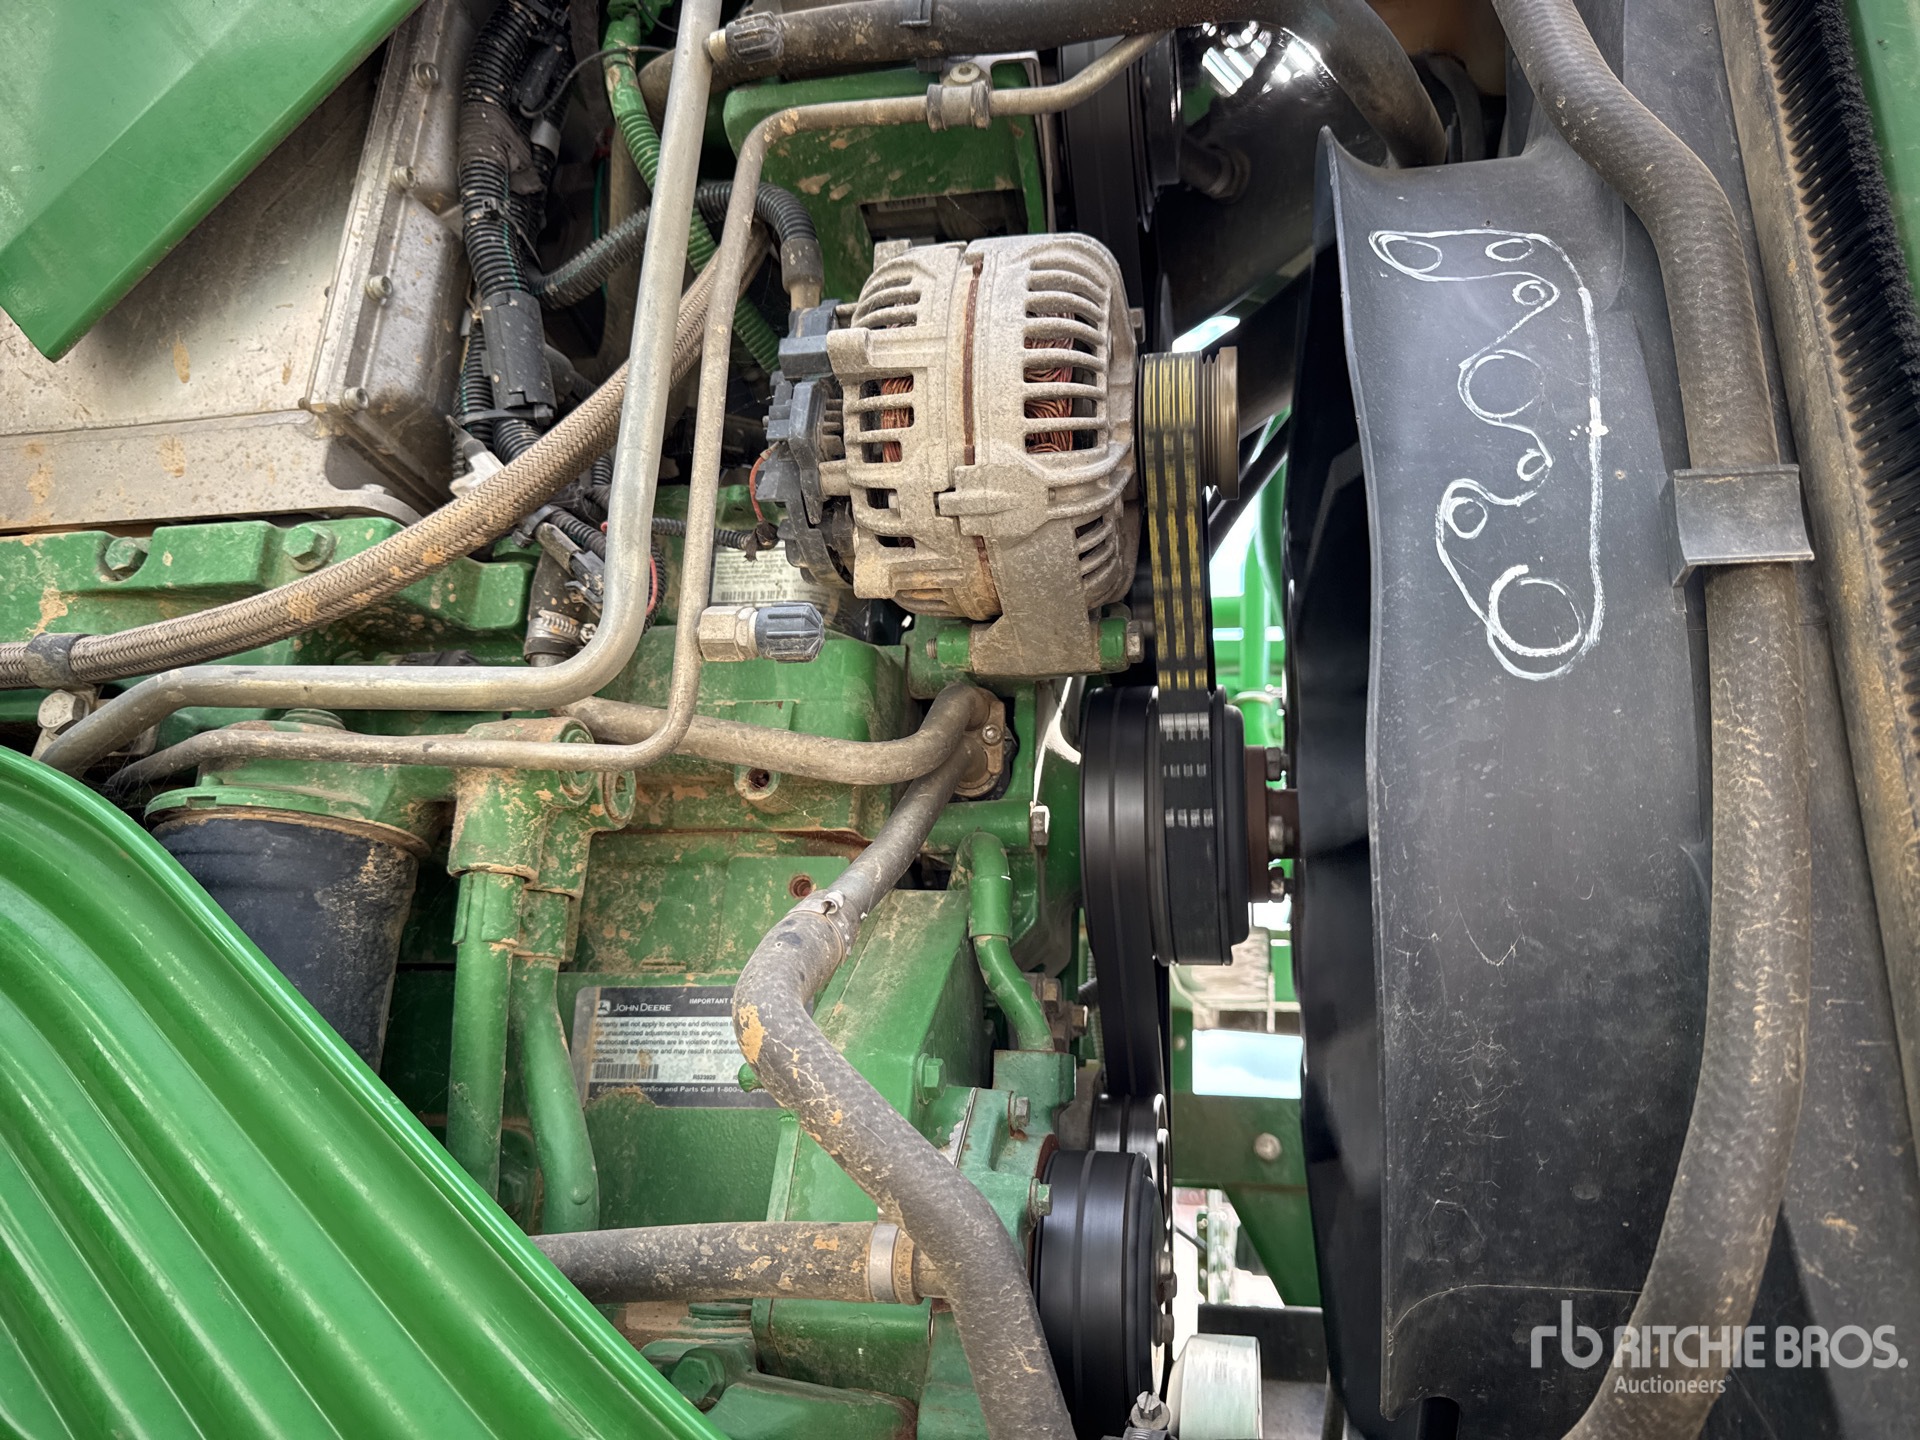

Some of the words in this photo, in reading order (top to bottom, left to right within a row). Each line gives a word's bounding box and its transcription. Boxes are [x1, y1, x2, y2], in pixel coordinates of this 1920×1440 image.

[613, 1003, 639, 1012] JOHN
[640, 1002, 672, 1012] DEERE
[641, 1021, 657, 1029] apply
[666, 1021, 687, 1029] engine
